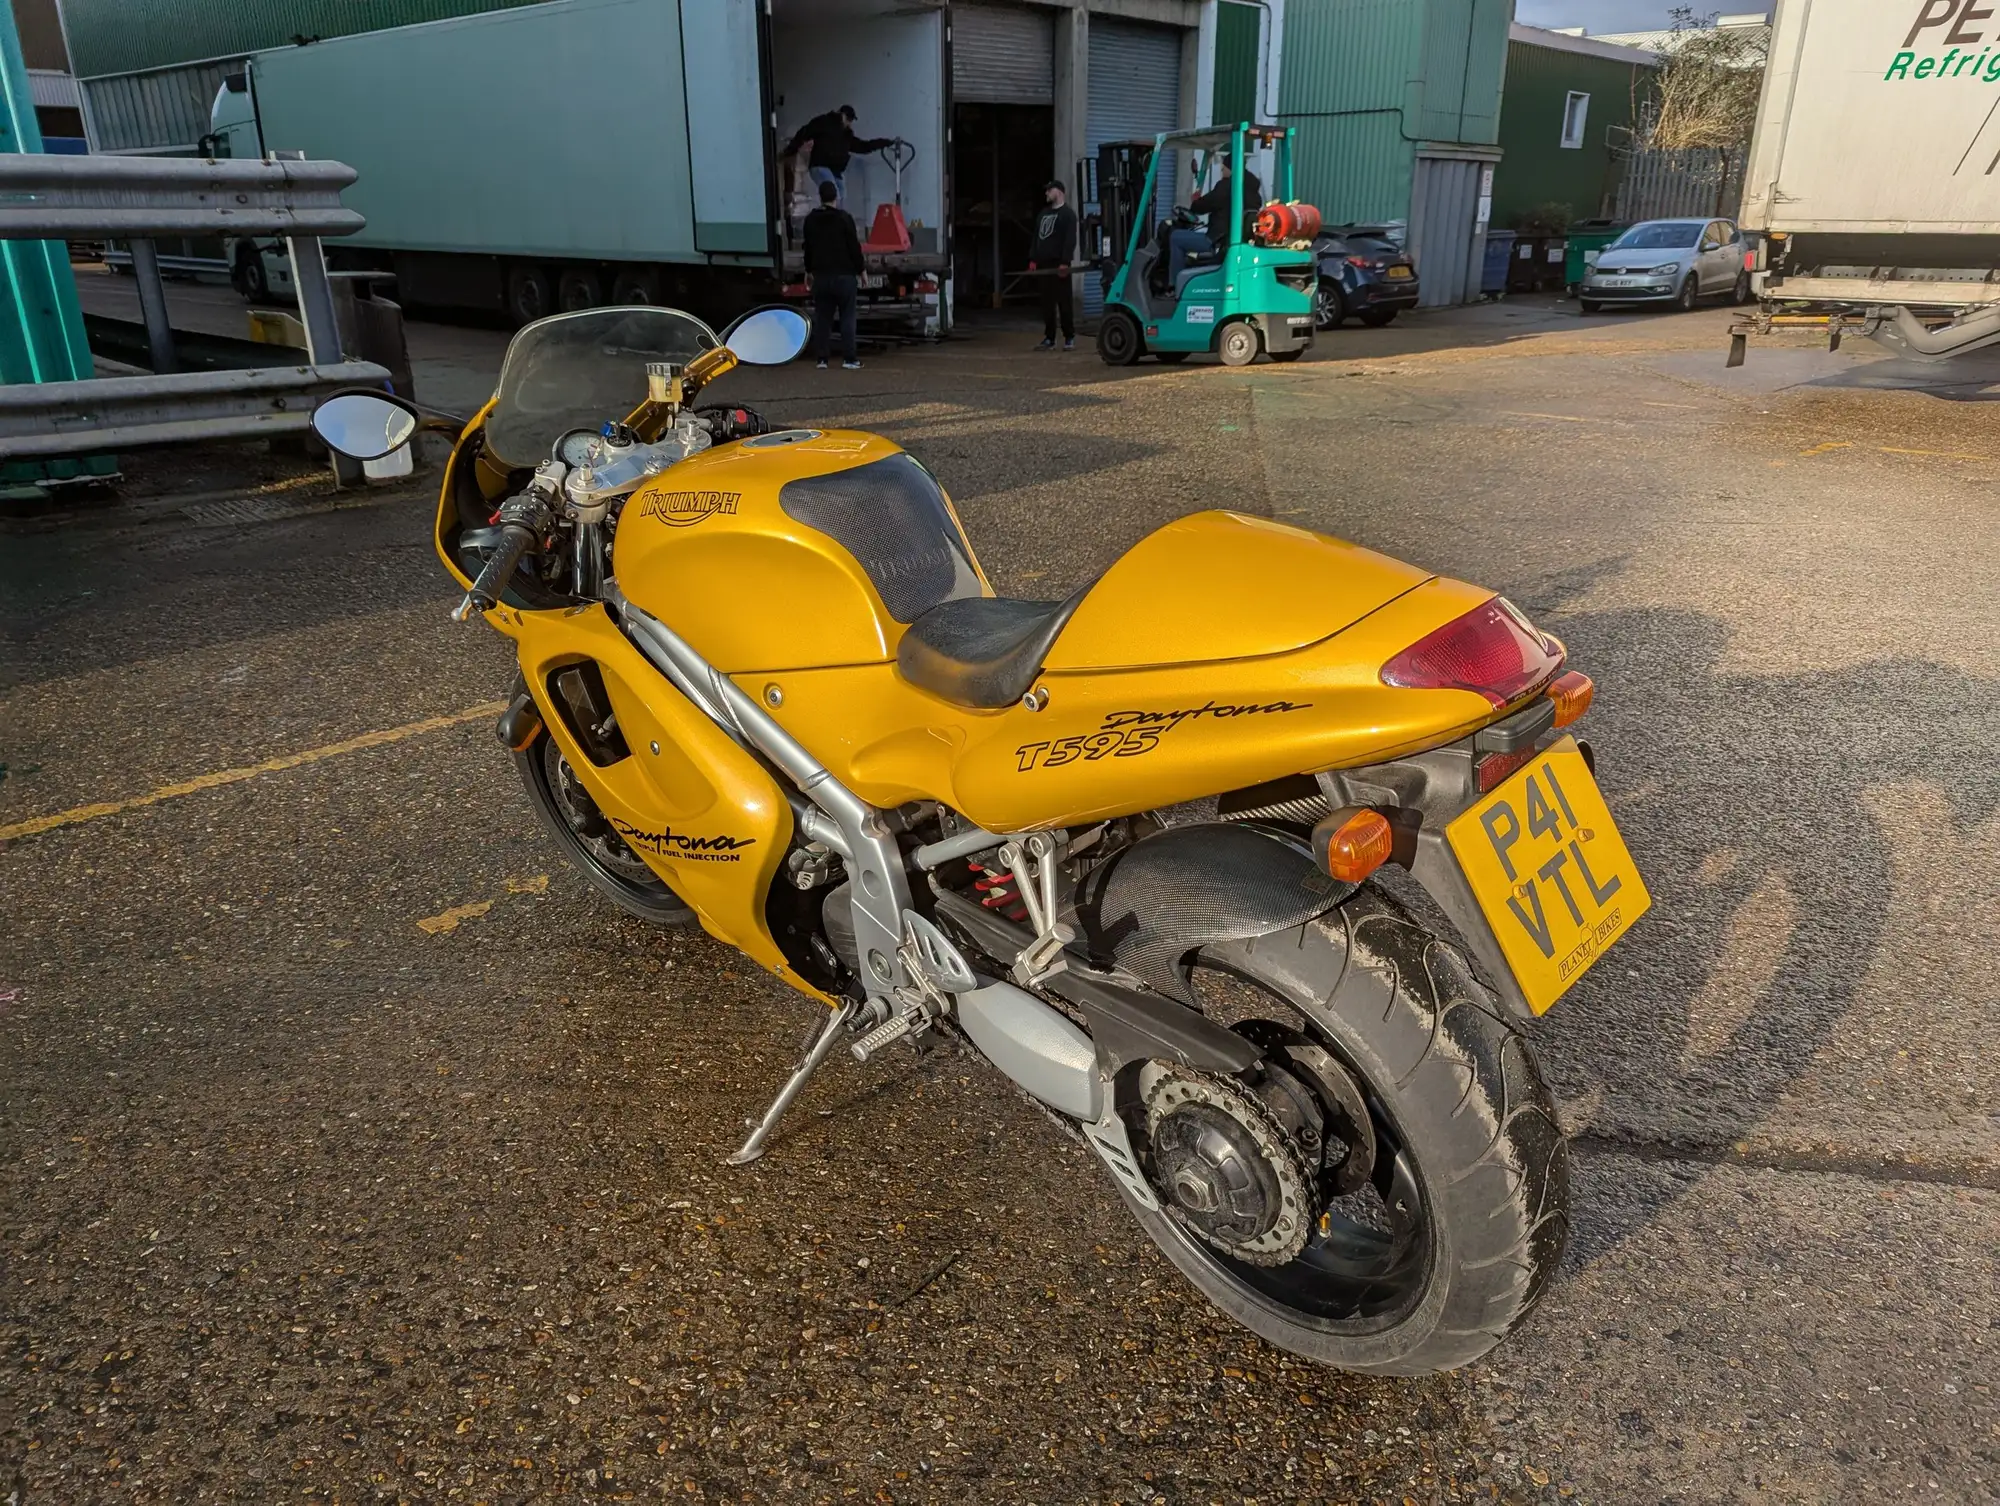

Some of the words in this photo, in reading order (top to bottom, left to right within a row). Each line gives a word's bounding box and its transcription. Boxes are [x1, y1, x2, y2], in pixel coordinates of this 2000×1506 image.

[1901, 0, 2000, 48] PE
[1884, 46, 2000, 82] Refrig
[640, 488, 742, 527] TRIUMPH
[1100, 701, 1313, 732] Daytona
[1015, 725, 1165, 772] T595
[612, 816, 757, 856] Daytona
[1479, 762, 1579, 883] P41
[662, 849, 682, 858] FUEL
[684, 852, 740, 862] INJECTION
[1505, 839, 1622, 959] VTL
[1560, 938, 1594, 978] PLANET
[1597, 910, 1620, 941] BIKES
